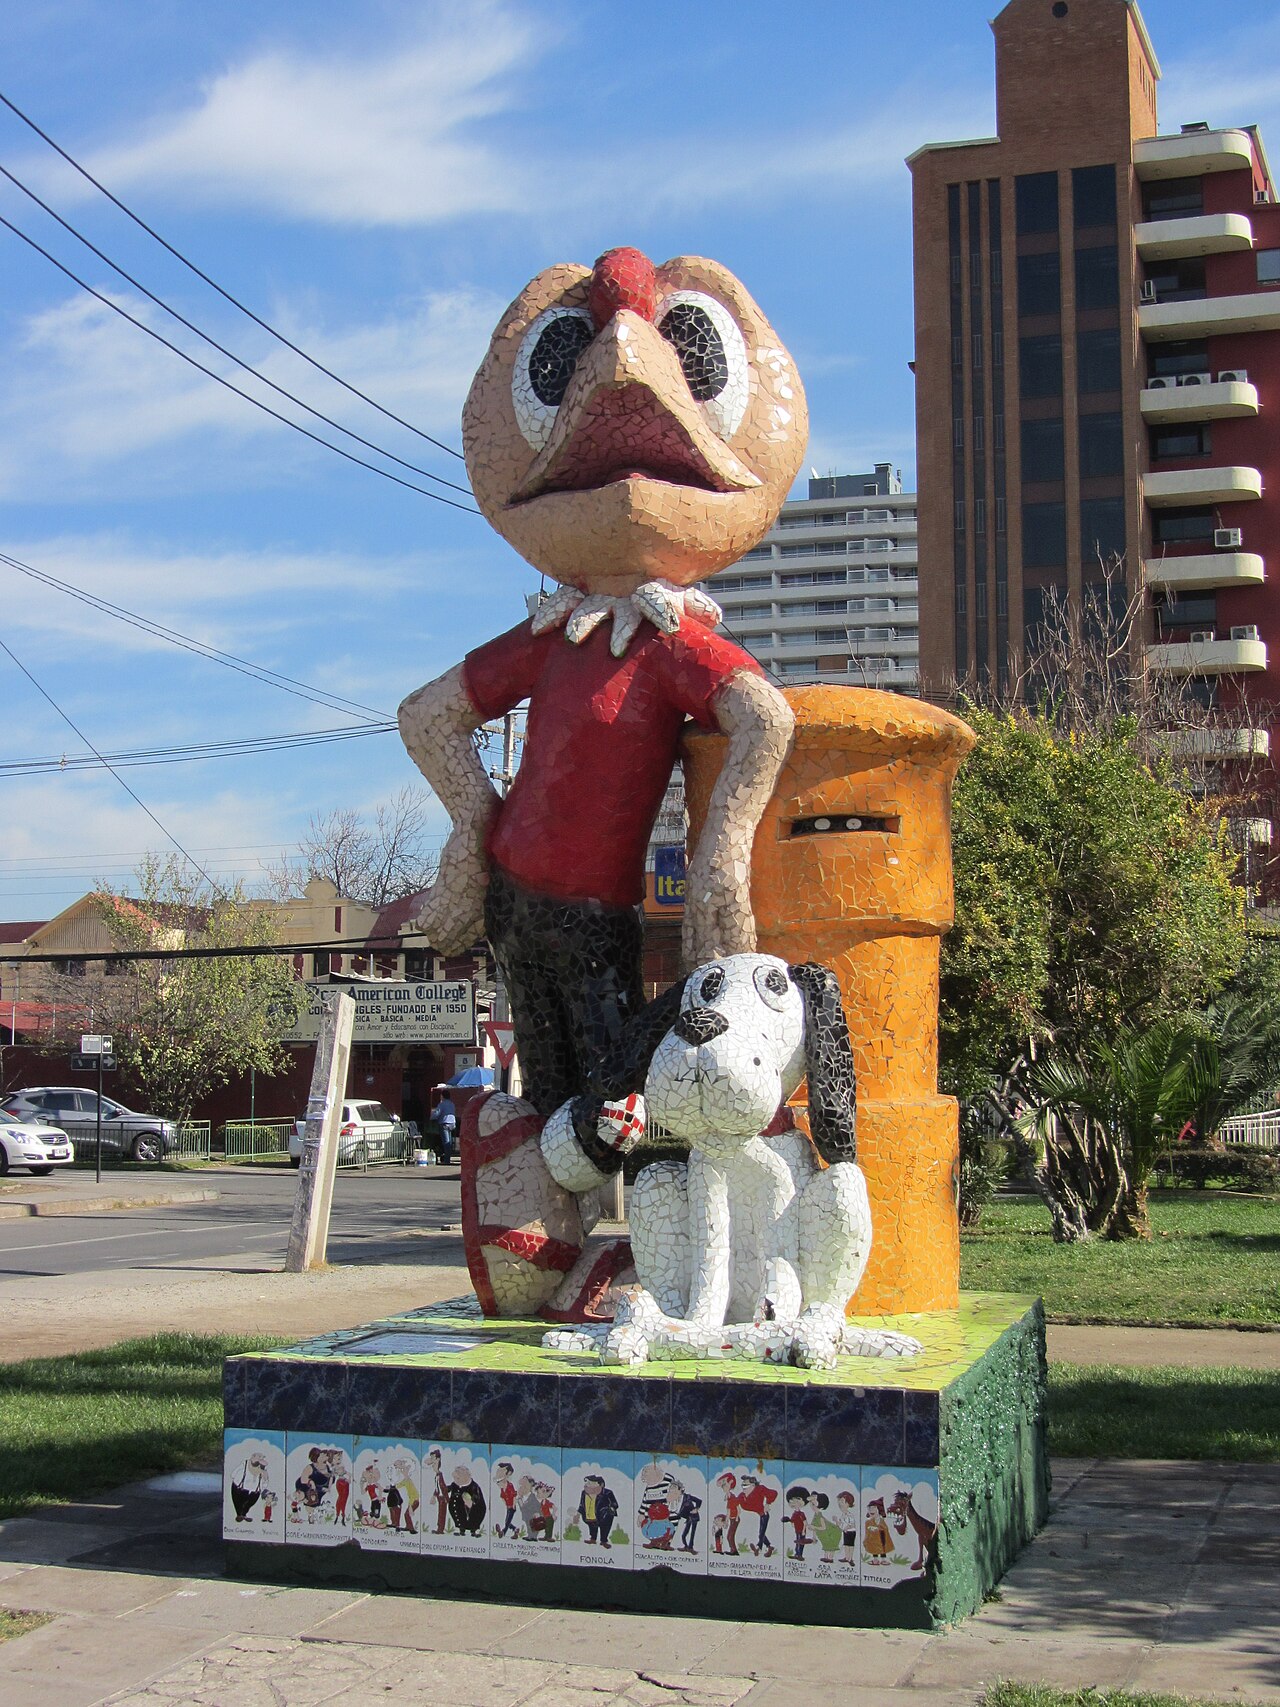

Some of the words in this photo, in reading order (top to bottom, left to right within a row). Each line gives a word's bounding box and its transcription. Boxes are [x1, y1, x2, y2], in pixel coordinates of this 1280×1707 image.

[658, 876, 686, 897] Ita
[348, 986, 410, 1001] American
[415, 985, 467, 1001] College
[431, 1004, 441, 1013] EN
[446, 1004, 467, 1013] 1950
[579, 1555, 615, 1565] FONOLA
[863, 1574, 892, 1584] TITICACO
